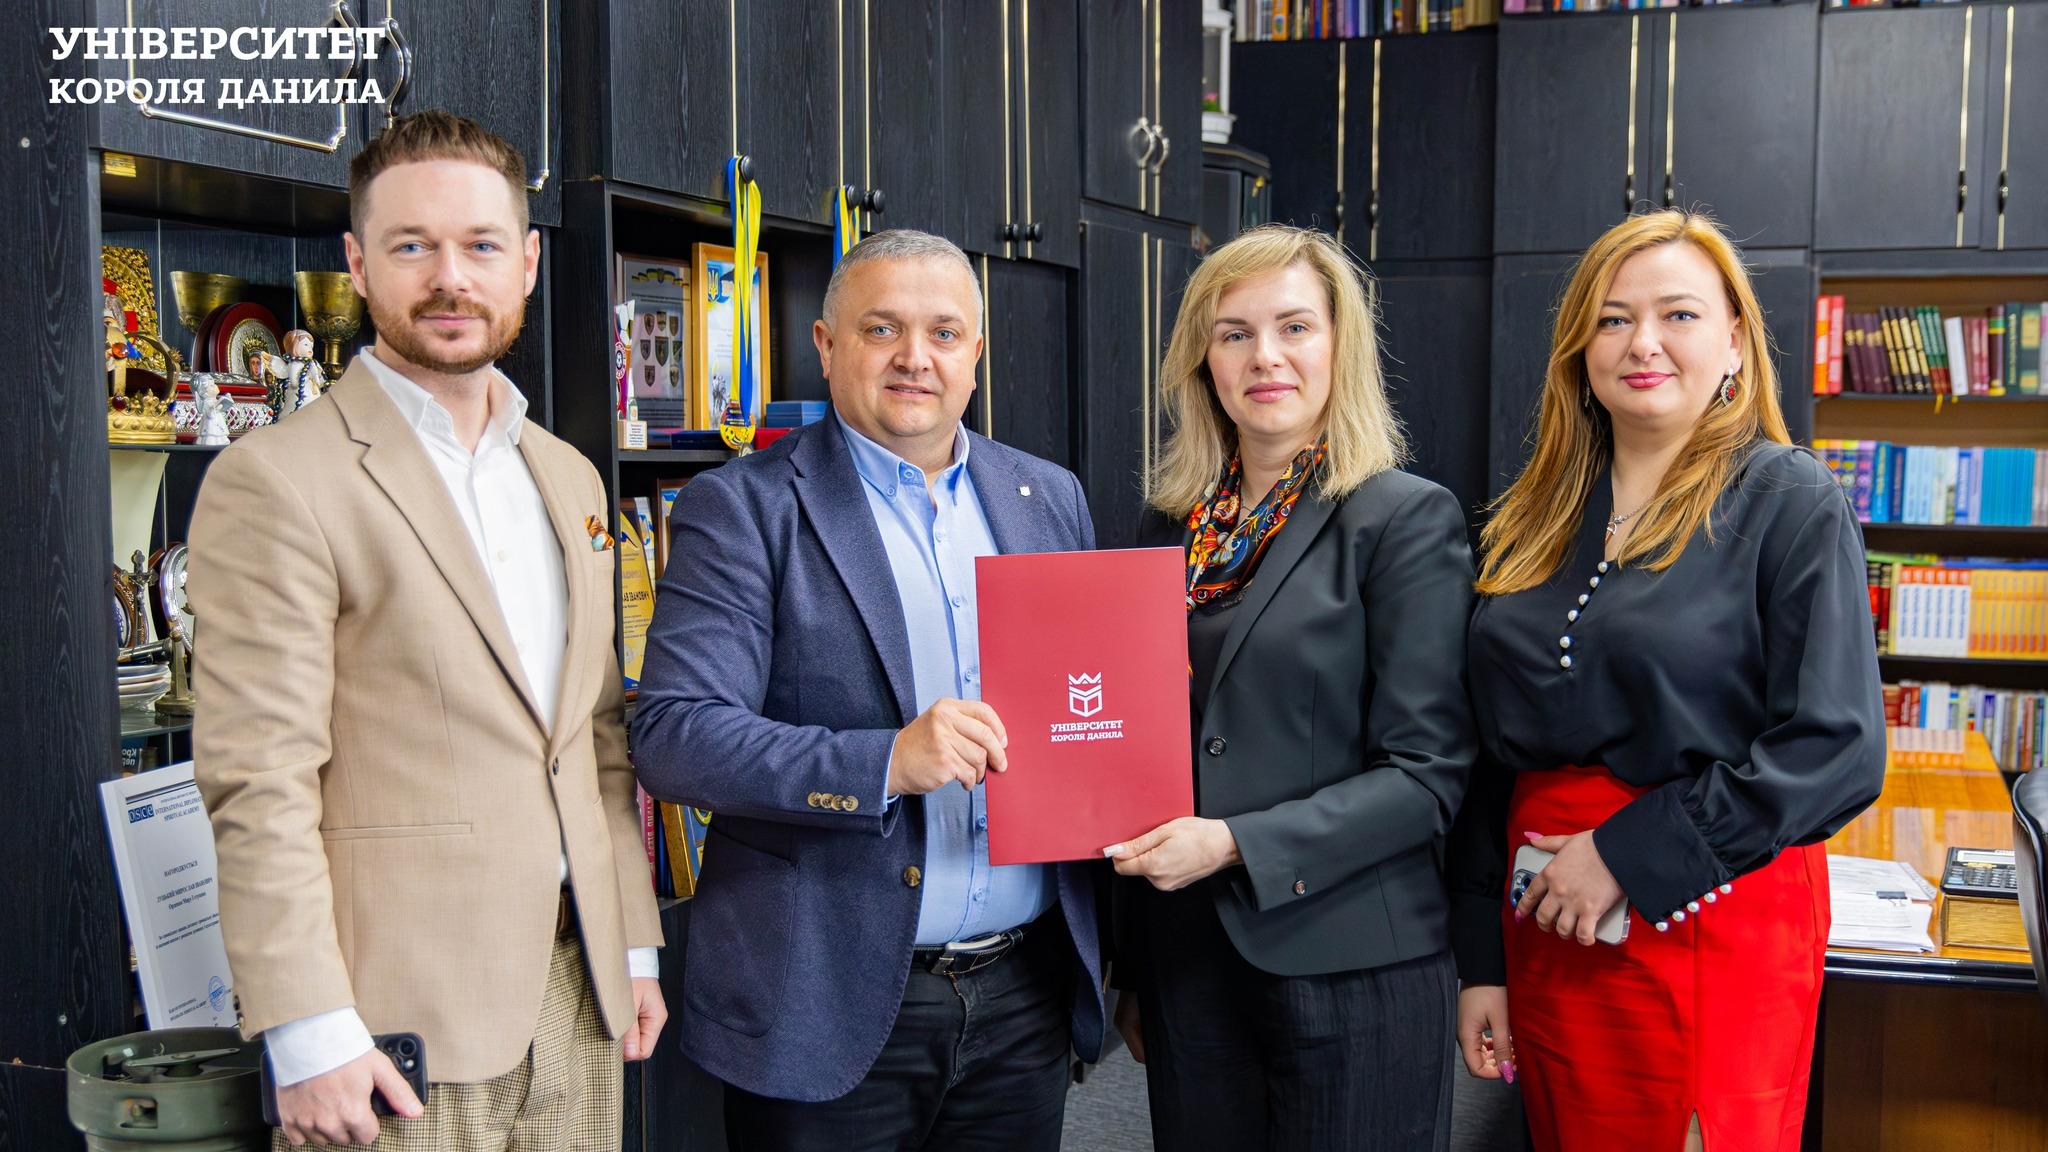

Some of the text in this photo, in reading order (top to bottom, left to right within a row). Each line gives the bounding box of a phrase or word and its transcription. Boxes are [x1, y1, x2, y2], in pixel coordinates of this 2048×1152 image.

[1050, 720, 1124, 733] УНІВЕРСИТЕТ
[1050, 731, 1124, 742] КОРОЛЯ ДАНИЛА
